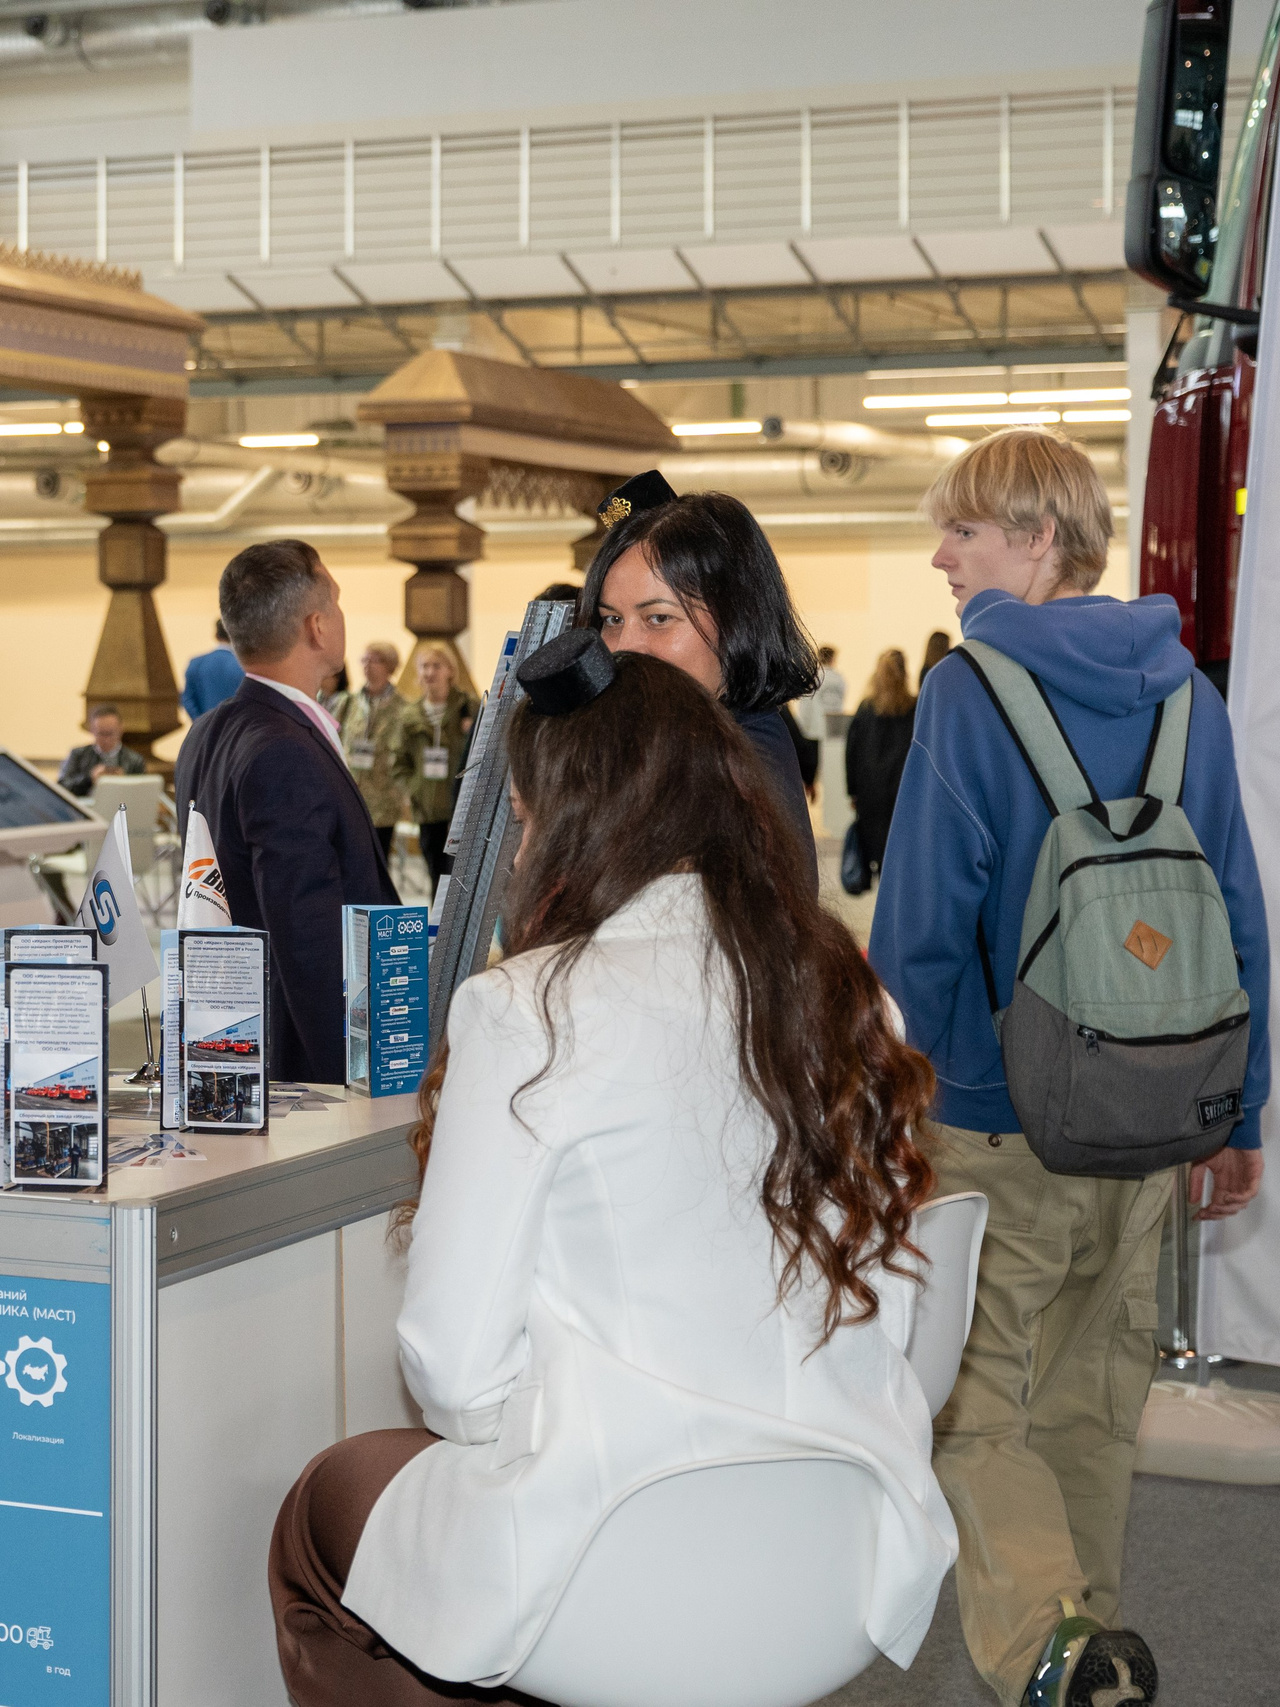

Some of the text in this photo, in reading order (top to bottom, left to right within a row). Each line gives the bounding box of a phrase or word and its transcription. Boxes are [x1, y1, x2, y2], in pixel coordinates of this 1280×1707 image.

[32, 1307, 76, 1325] (МАСТ)
[12, 1432, 65, 1444] Локализация
[46, 1665, 71, 1677] в год
